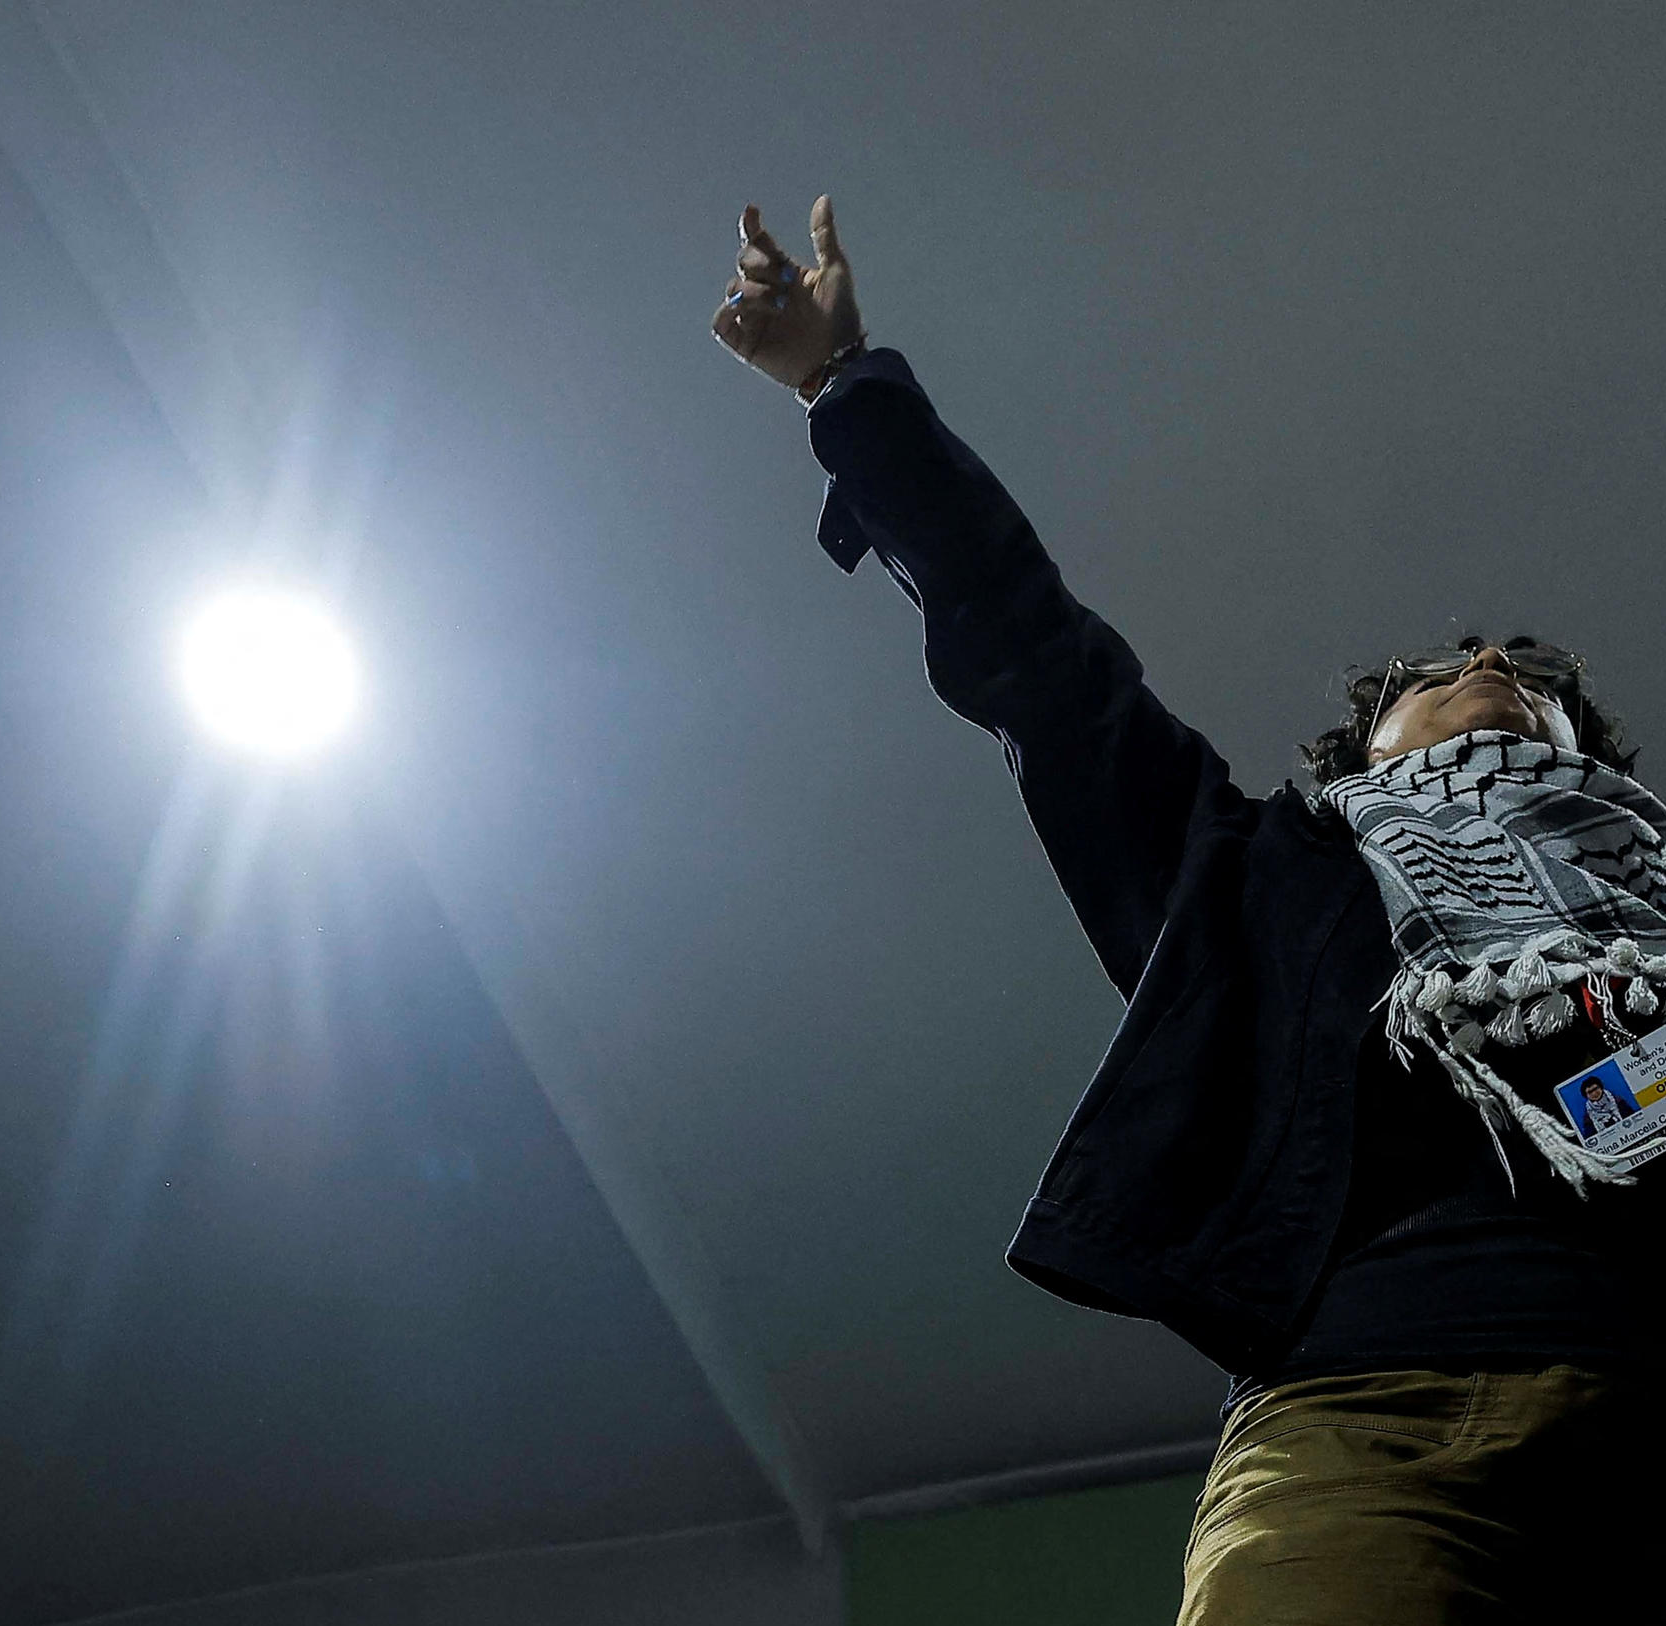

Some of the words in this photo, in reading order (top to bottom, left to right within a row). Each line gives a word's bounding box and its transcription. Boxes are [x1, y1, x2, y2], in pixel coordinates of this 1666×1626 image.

[1624, 1043, 1665, 1072] Women's
[1639, 1063, 1656, 1077] and
[1620, 1121, 1658, 1145] Marcela
